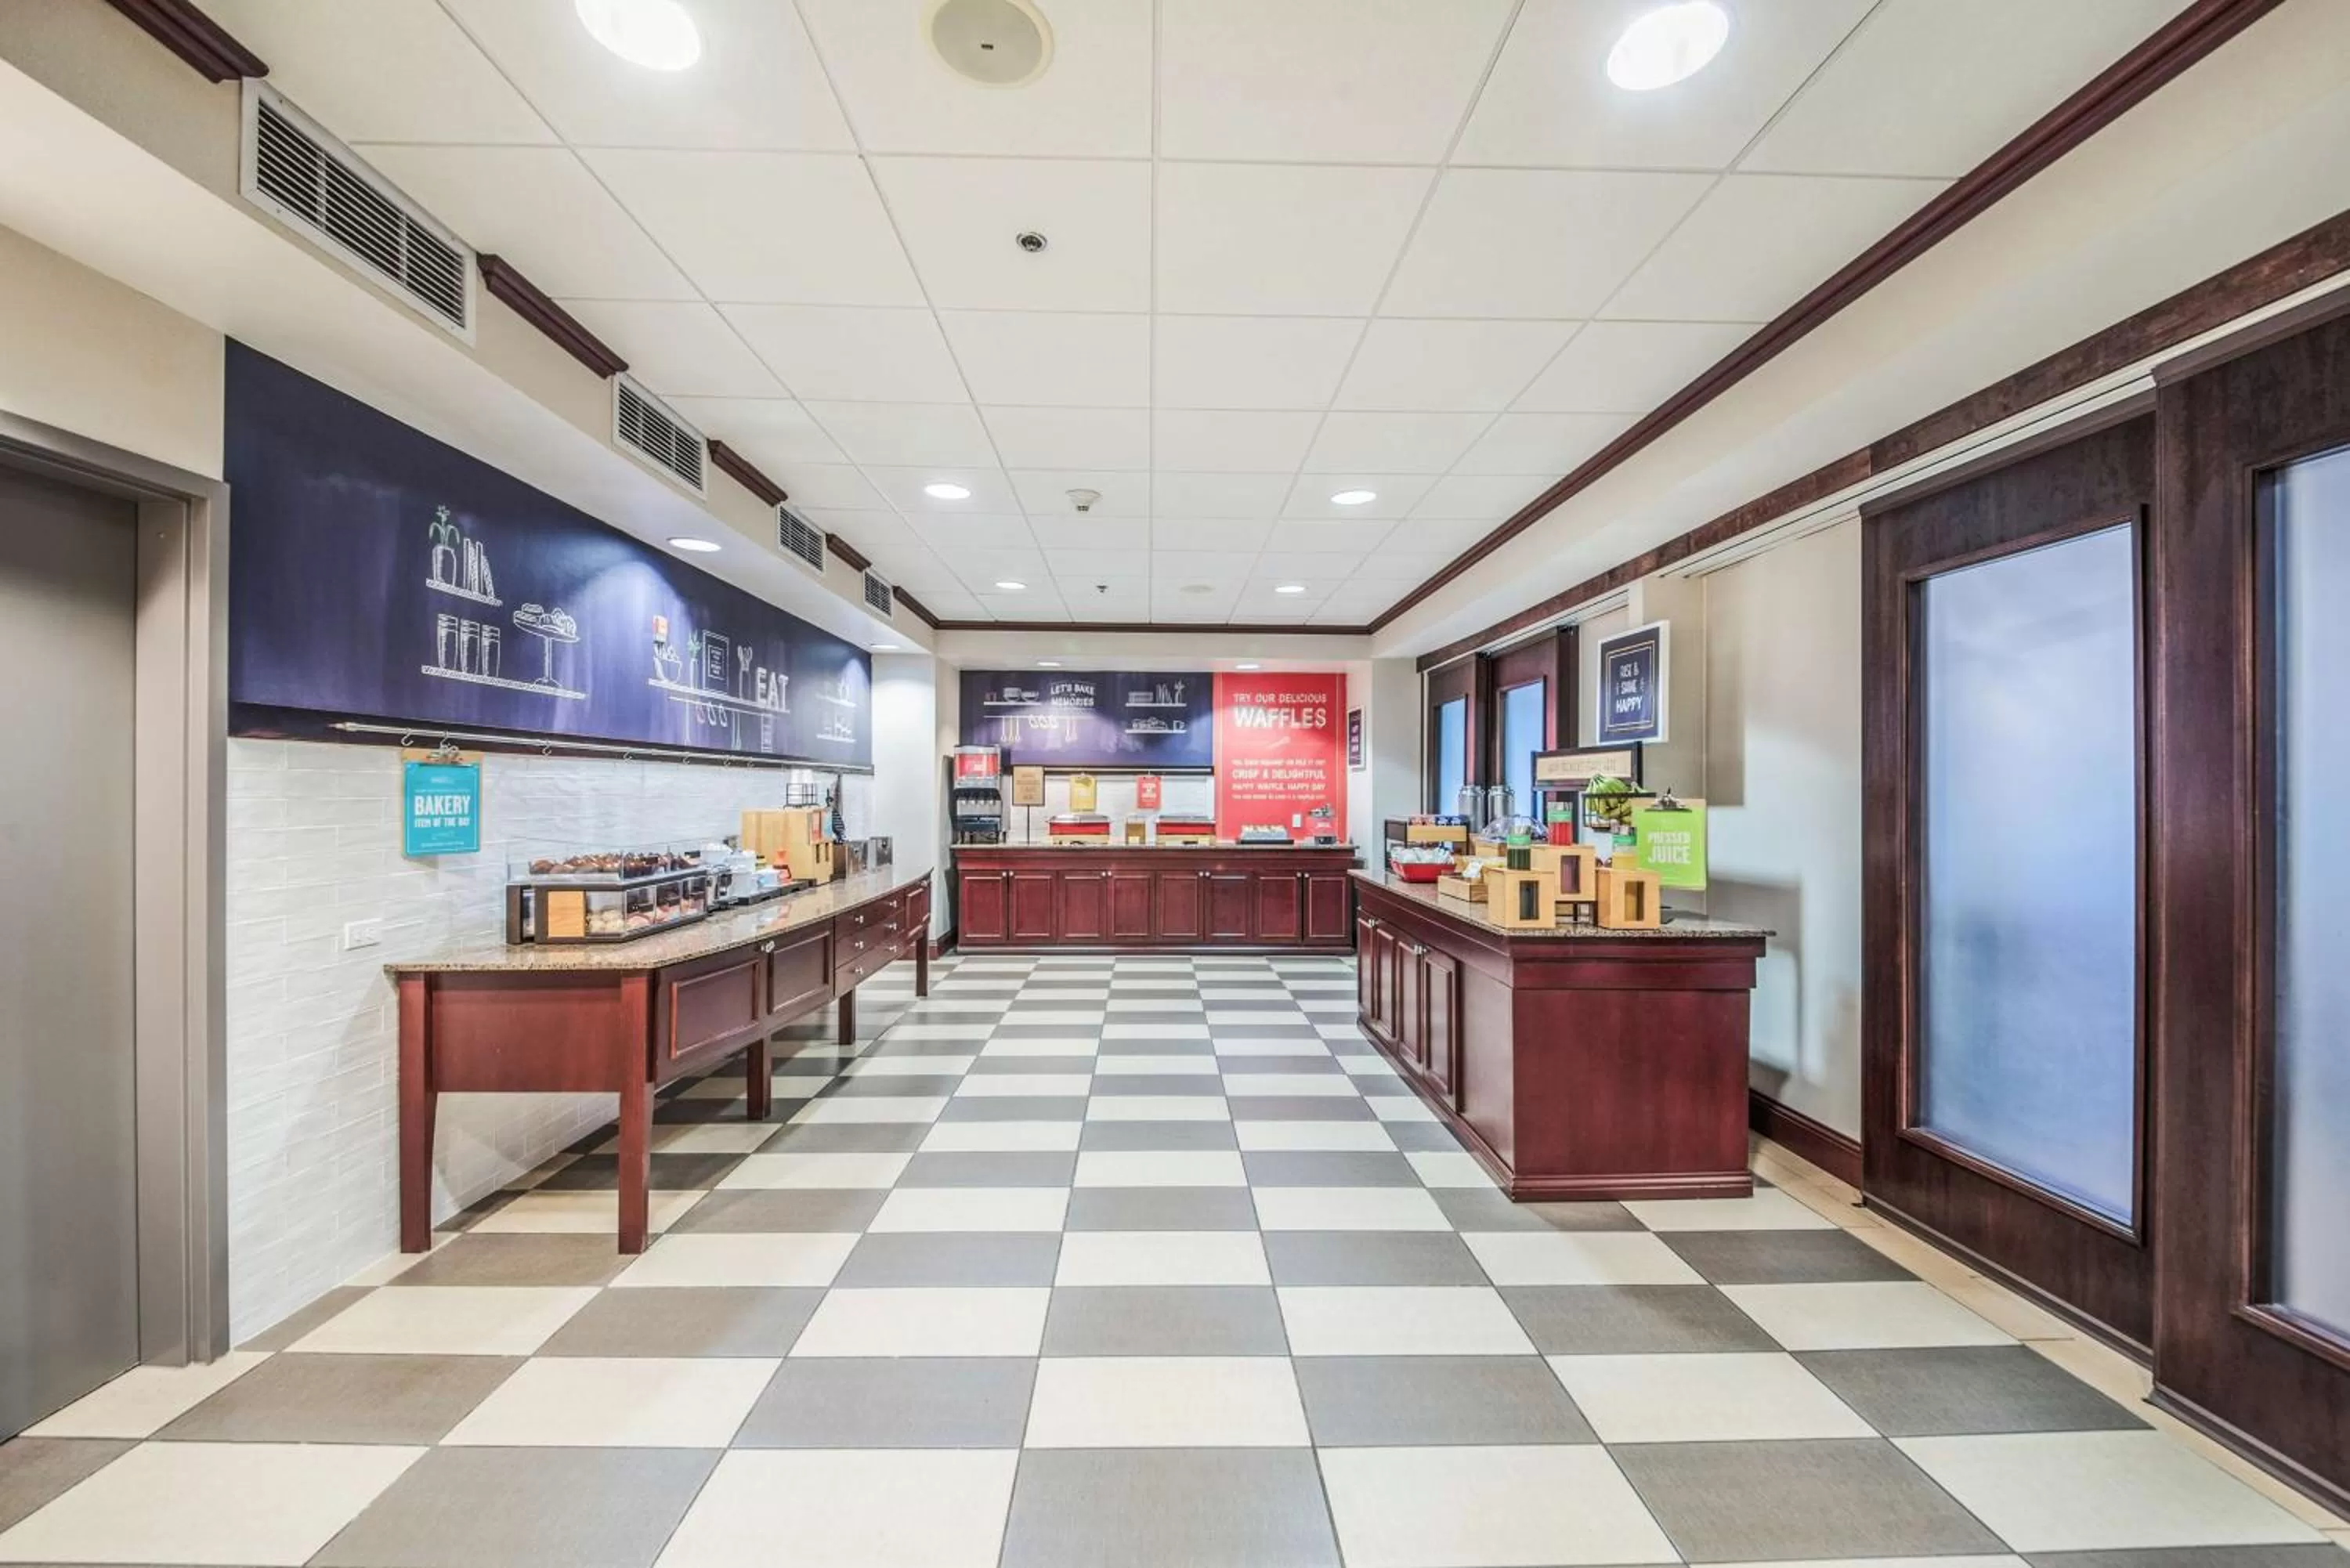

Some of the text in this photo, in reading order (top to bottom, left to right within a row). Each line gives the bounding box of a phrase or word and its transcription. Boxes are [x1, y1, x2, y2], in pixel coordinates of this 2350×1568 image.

[754, 667, 789, 712] EAT
[1050, 684, 1094, 696] LET'S BAKE
[1234, 693, 1327, 703] TRY OUR DELICIOUS
[1615, 695, 1643, 714] HAPPY
[1234, 707, 1327, 728] WAFFLES
[1232, 769, 1258, 780] CRISP
[1272, 769, 1326, 780] DELIGHTFUL
[414, 795, 470, 815] BAKERY
[432, 818, 441, 827] OF
[444, 818, 456, 826] THE
[1647, 846, 1691, 865] JUICE
